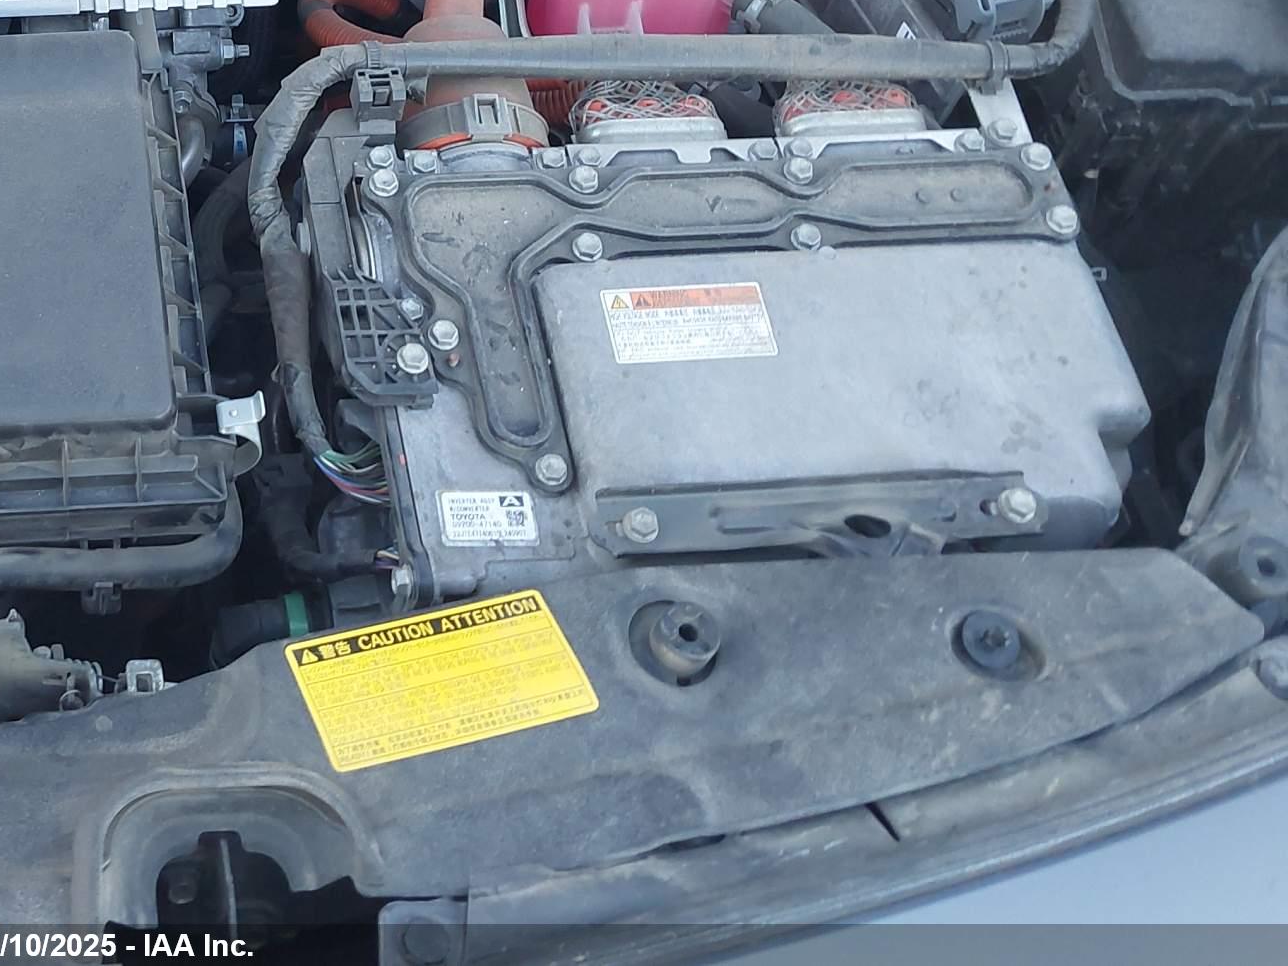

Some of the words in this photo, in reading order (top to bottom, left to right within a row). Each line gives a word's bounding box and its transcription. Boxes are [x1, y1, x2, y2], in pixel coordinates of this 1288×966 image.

[450, 513, 486, 521] TOYOTA
[358, 621, 434, 652] CAUTION
[440, 596, 538, 633] ATTENTION
